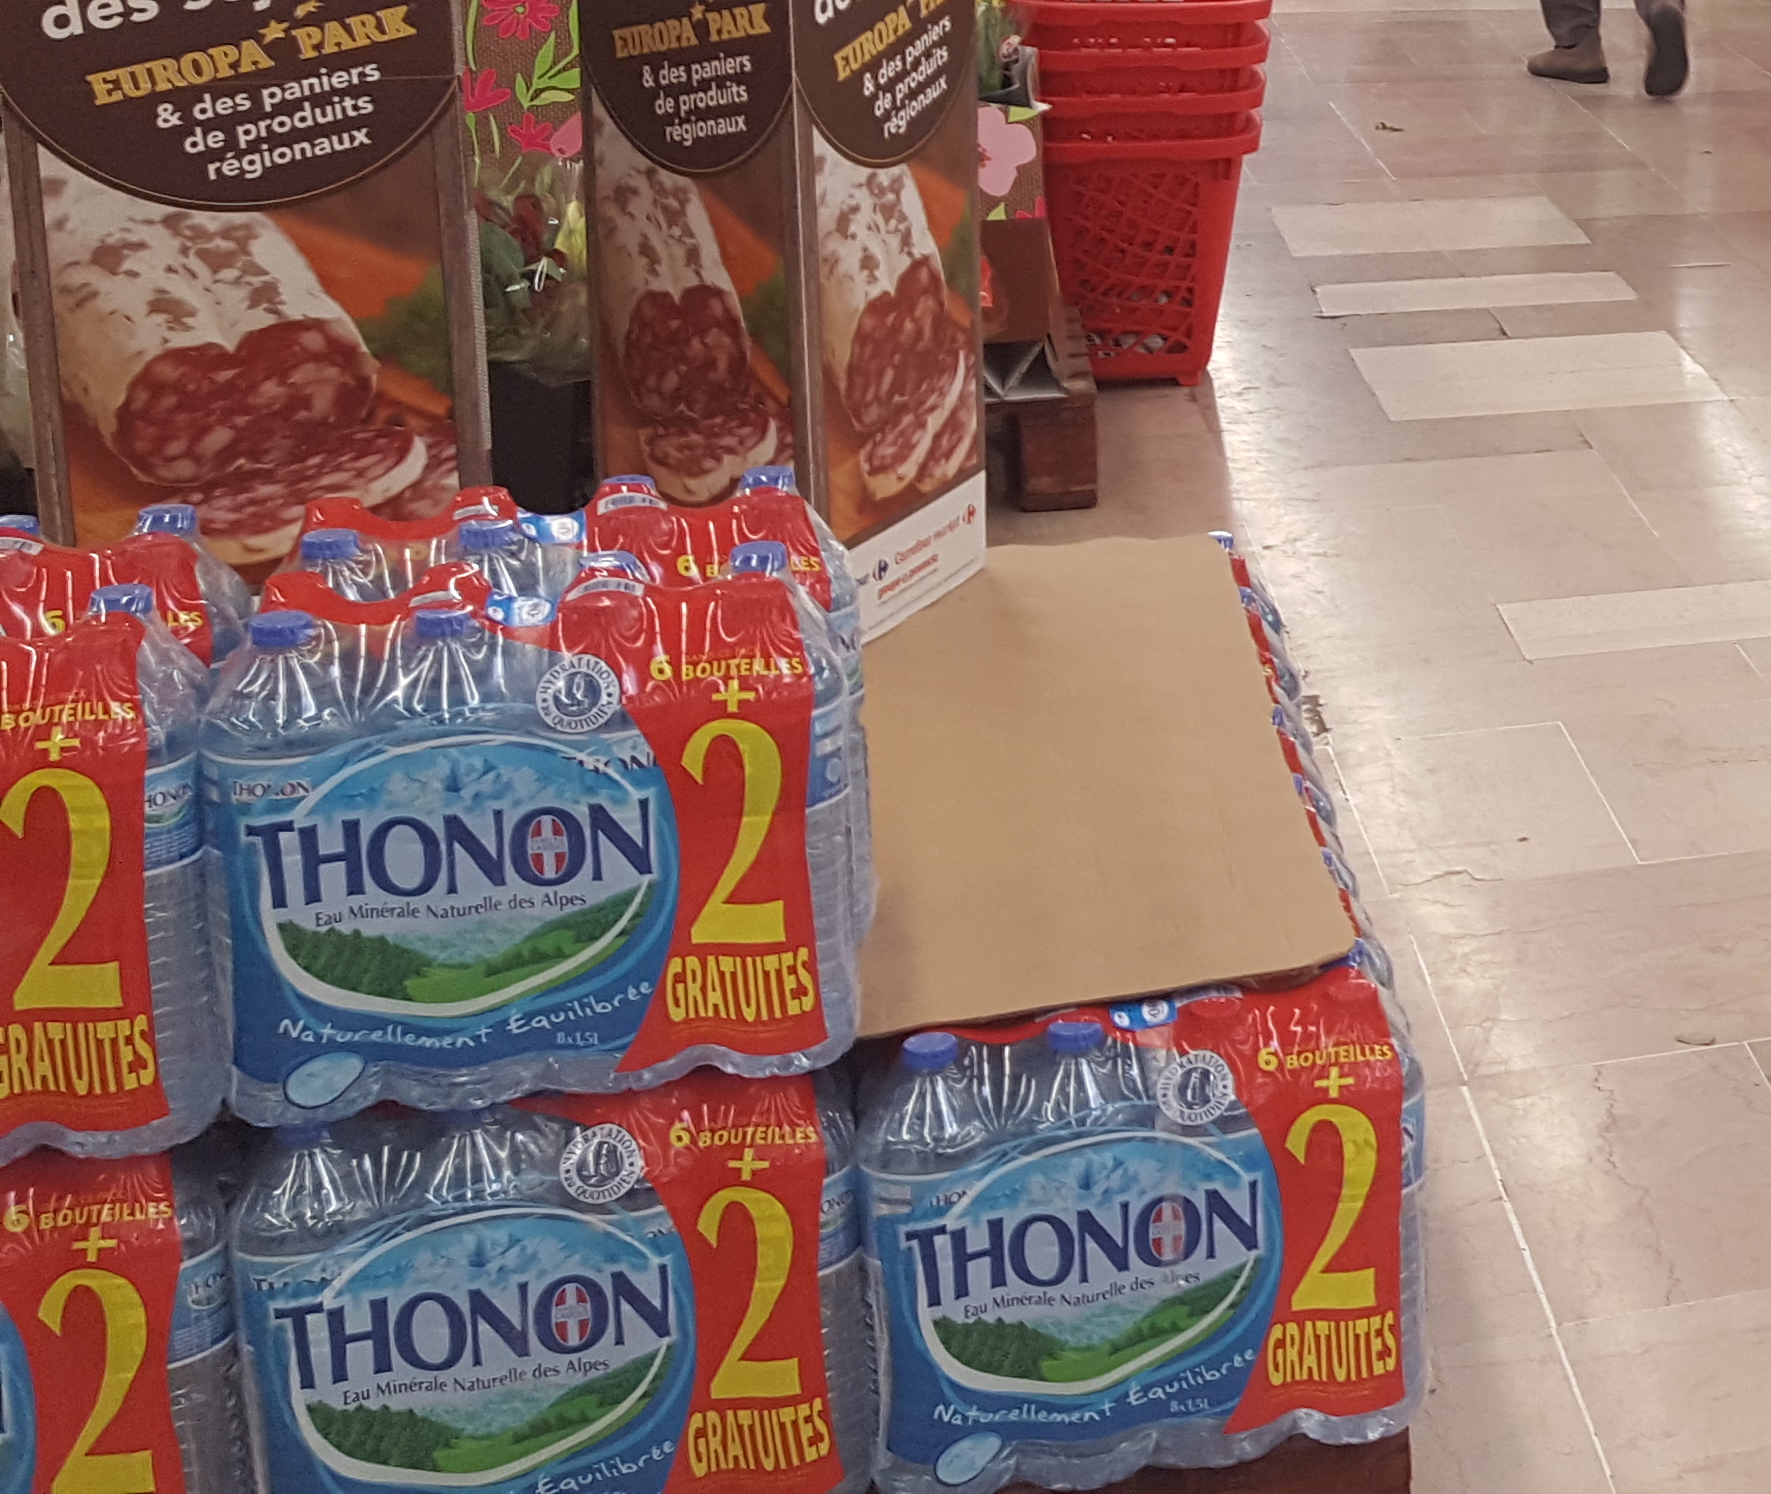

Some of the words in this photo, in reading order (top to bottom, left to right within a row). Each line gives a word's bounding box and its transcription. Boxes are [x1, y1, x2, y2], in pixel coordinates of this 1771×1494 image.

[85, 38, 275, 106] EUROPA
[293, 5, 417, 59] PARK
[612, 17, 699, 59] EUROPA
[707, 3, 771, 42] PARK
[835, 10, 914, 81] EUROPA
[155, 103, 183, 129] &
[193, 89, 251, 121] des
[261, 62, 381, 111] paniers
[183, 123, 226, 154] de
[236, 95, 374, 143] produits
[206, 128, 372, 181] régionaux
[681, 657, 804, 680] BOUTEILLES
[244, 797, 653, 909] THONON
[677, 718, 786, 944] 2
[0, 768, 123, 1010] 2
[314, 910, 343, 928] Eau
[350, 901, 420, 921] Minérale
[426, 893, 502, 919] Naturelle
[508, 892, 535, 909] des
[541, 891, 587, 912] Alpes
[278, 1017, 493, 1049] Naturellement
[505, 980, 654, 1034] Équilibrée
[667, 948, 816, 1022] GRATUITES
[1285, 1044, 1393, 1068] BOUTEILLES
[698, 1125, 817, 1147] BOUTEILLES
[39, 1200, 172, 1231] BOUTEILLES
[904, 1179, 1258, 1306] THONON
[1284, 1104, 1378, 1310] 2
[274, 1262, 670, 1390] THONON
[696, 1186, 803, 1399] 2
[36, 1269, 153, 1494] 2
[1267, 1312, 1396, 1386] GRATUITES
[687, 1398, 832, 1479] GRATUITES
